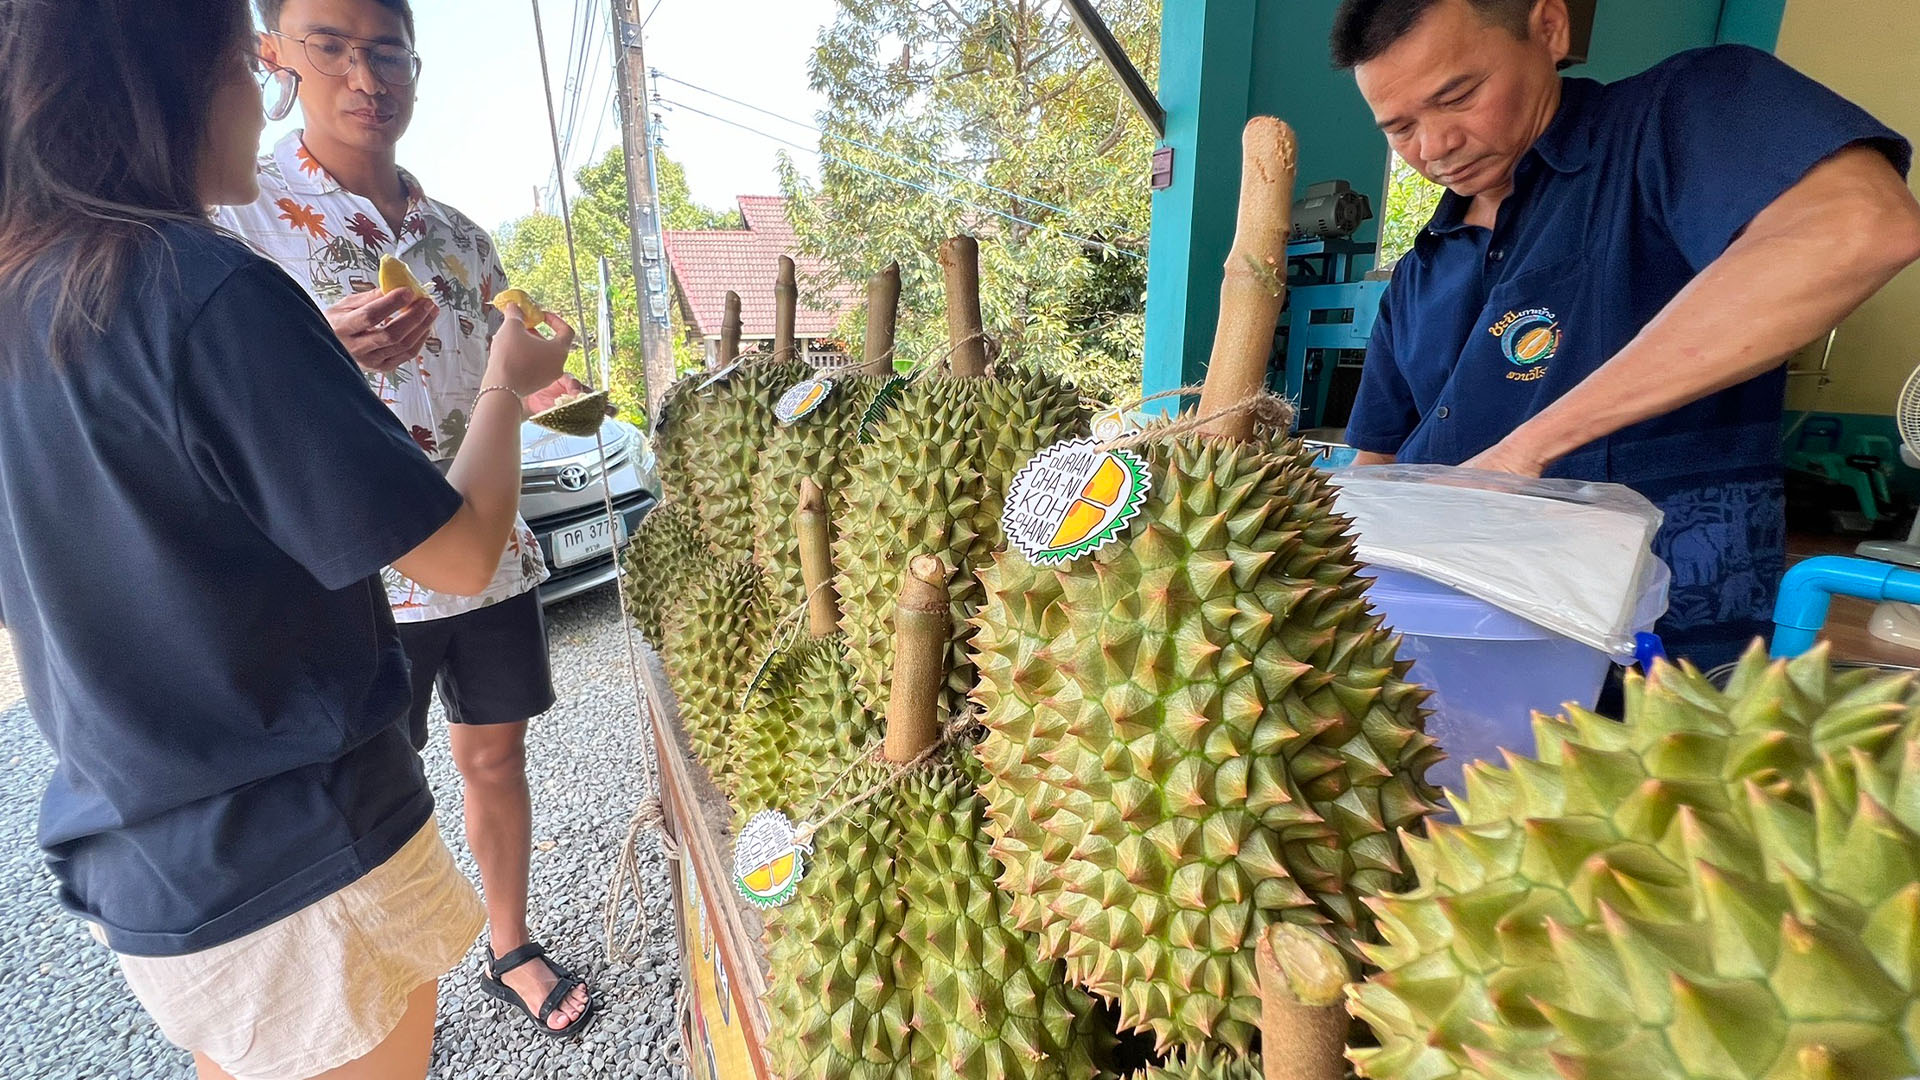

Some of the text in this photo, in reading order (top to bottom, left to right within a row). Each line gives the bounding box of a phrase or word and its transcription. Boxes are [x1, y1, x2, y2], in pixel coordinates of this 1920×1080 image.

[1050, 452, 1096, 478] DURIAN
[1030, 467, 1082, 499] CHA-NI
[1019, 489, 1069, 522] KOH
[1015, 512, 1054, 545] CHANG
